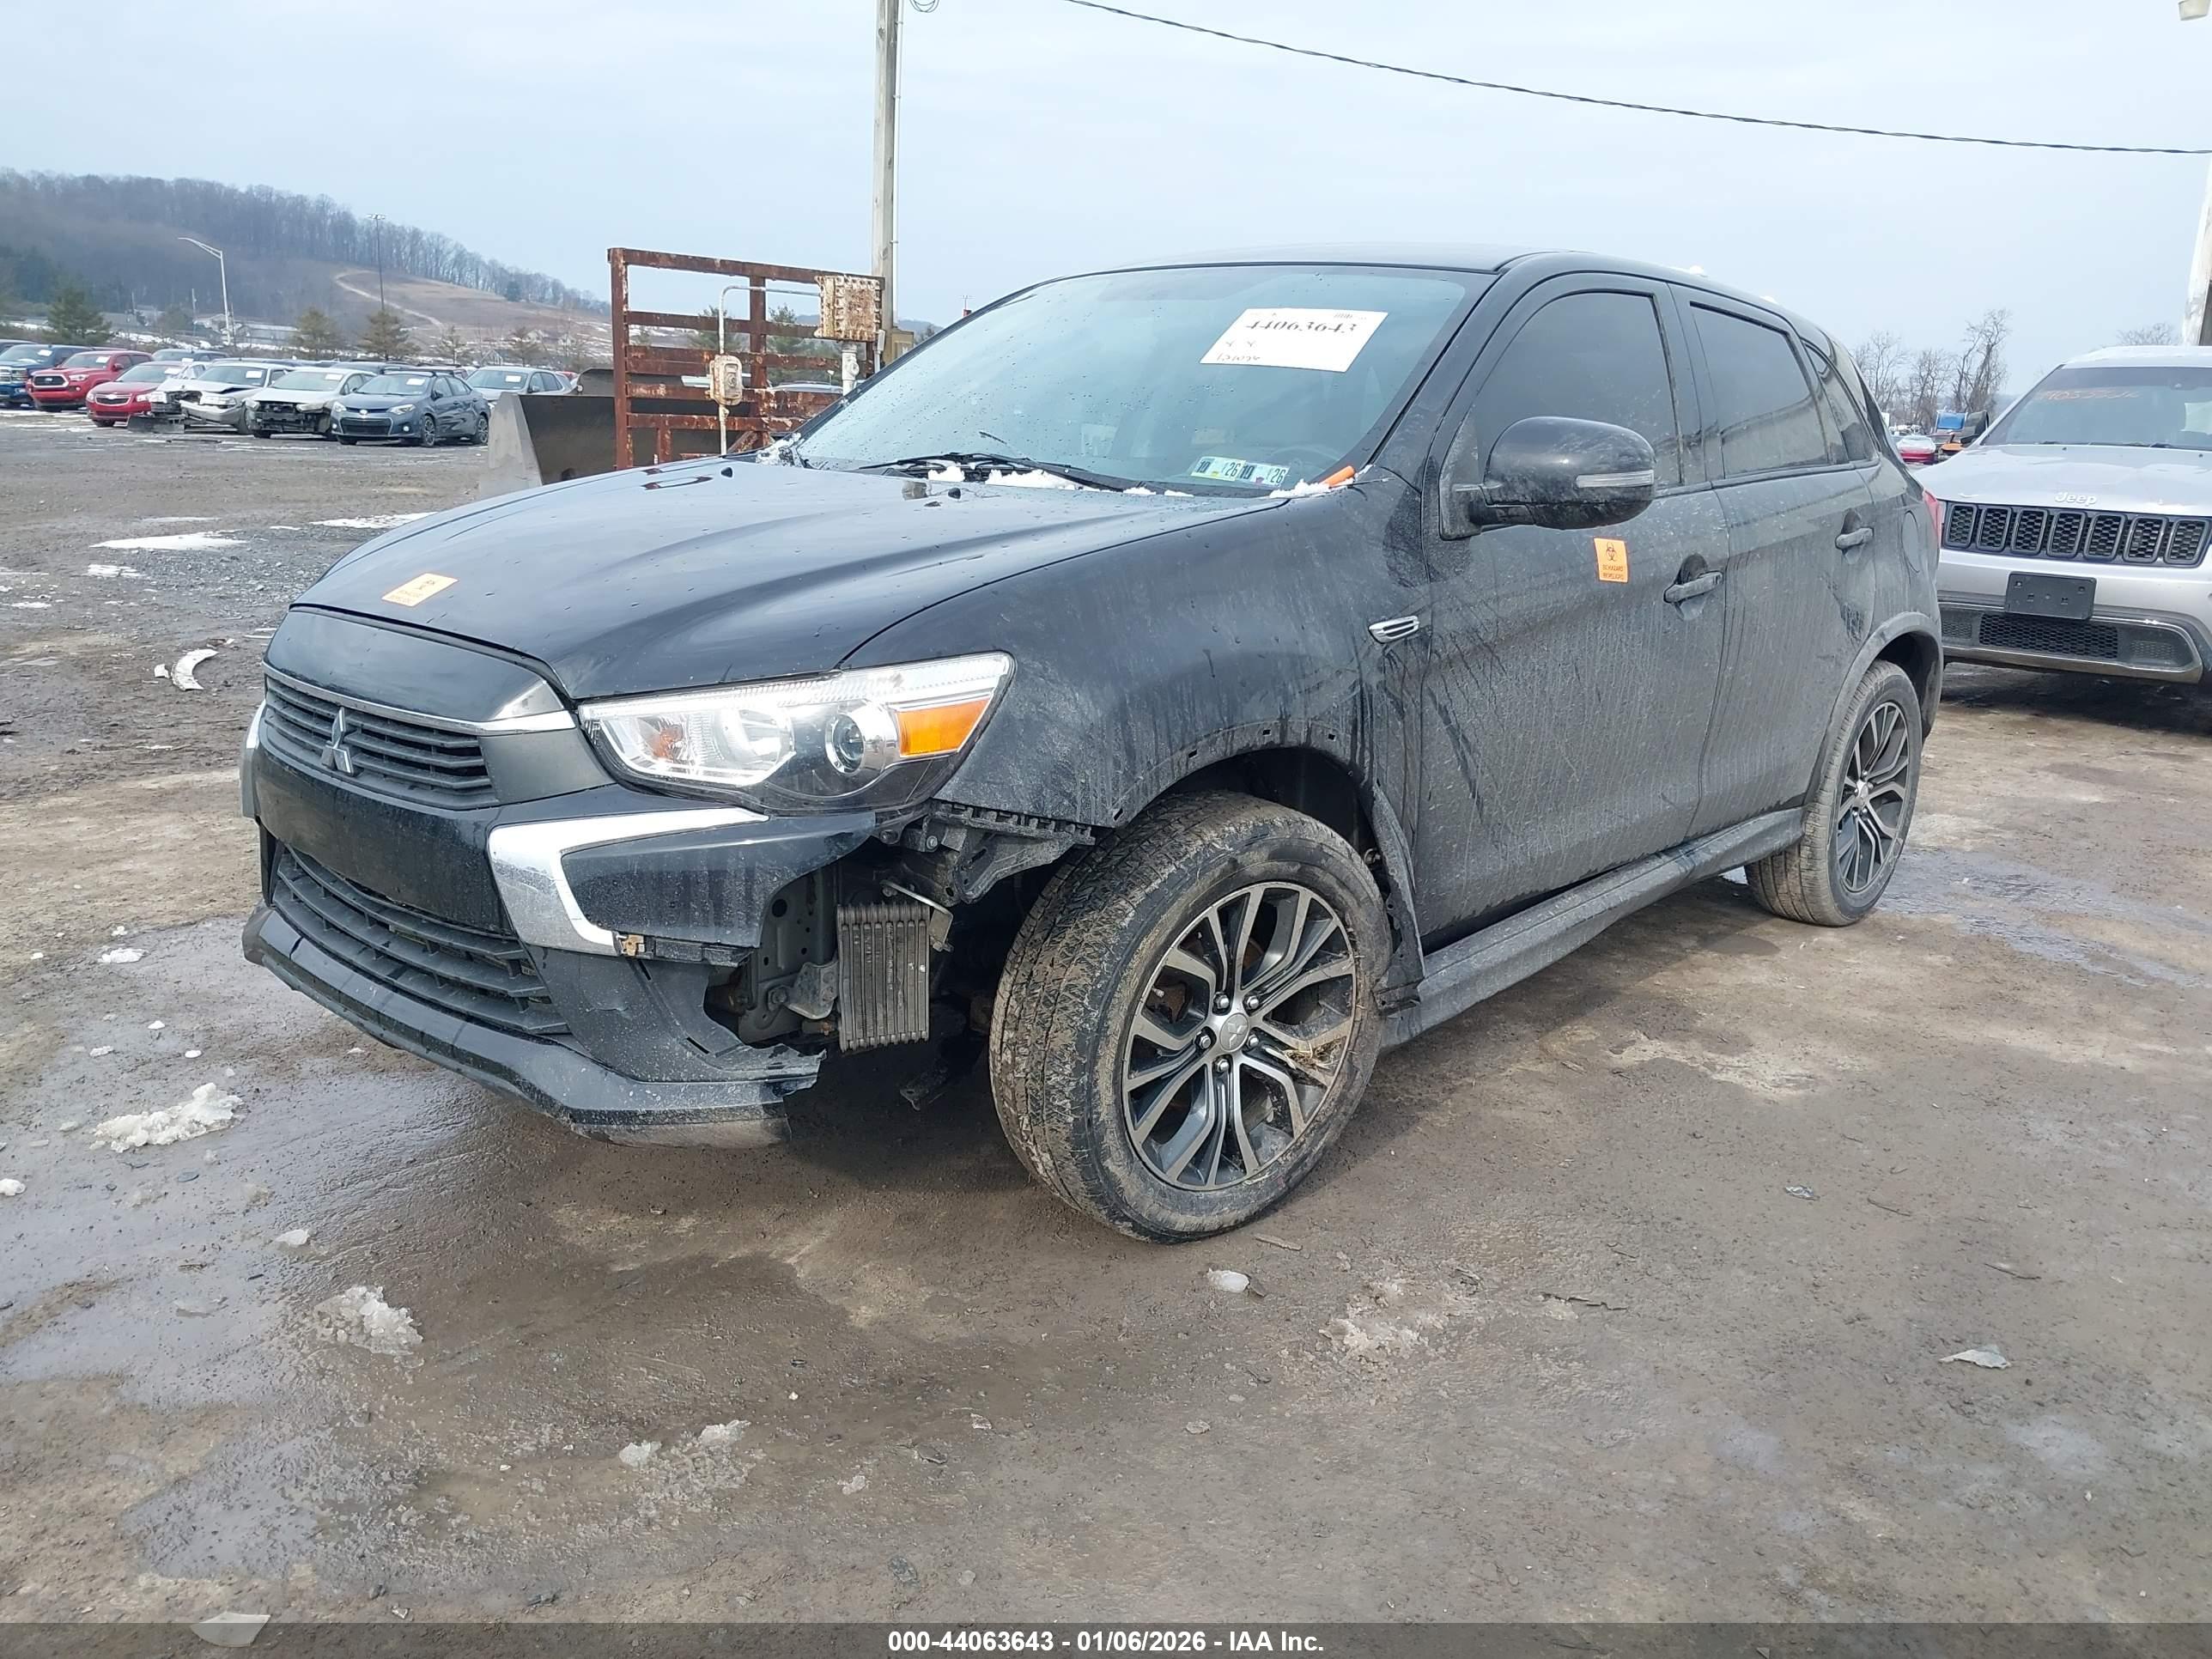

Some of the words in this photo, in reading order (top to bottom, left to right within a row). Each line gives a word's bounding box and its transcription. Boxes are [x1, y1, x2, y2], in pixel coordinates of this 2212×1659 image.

[1245, 320, 1358, 334] 44063643
[1196, 460, 1211, 473] 10
[1224, 462, 1241, 477] 26
[1270, 468, 1285, 483] 26
[2055, 491, 2097, 507] Jeep
